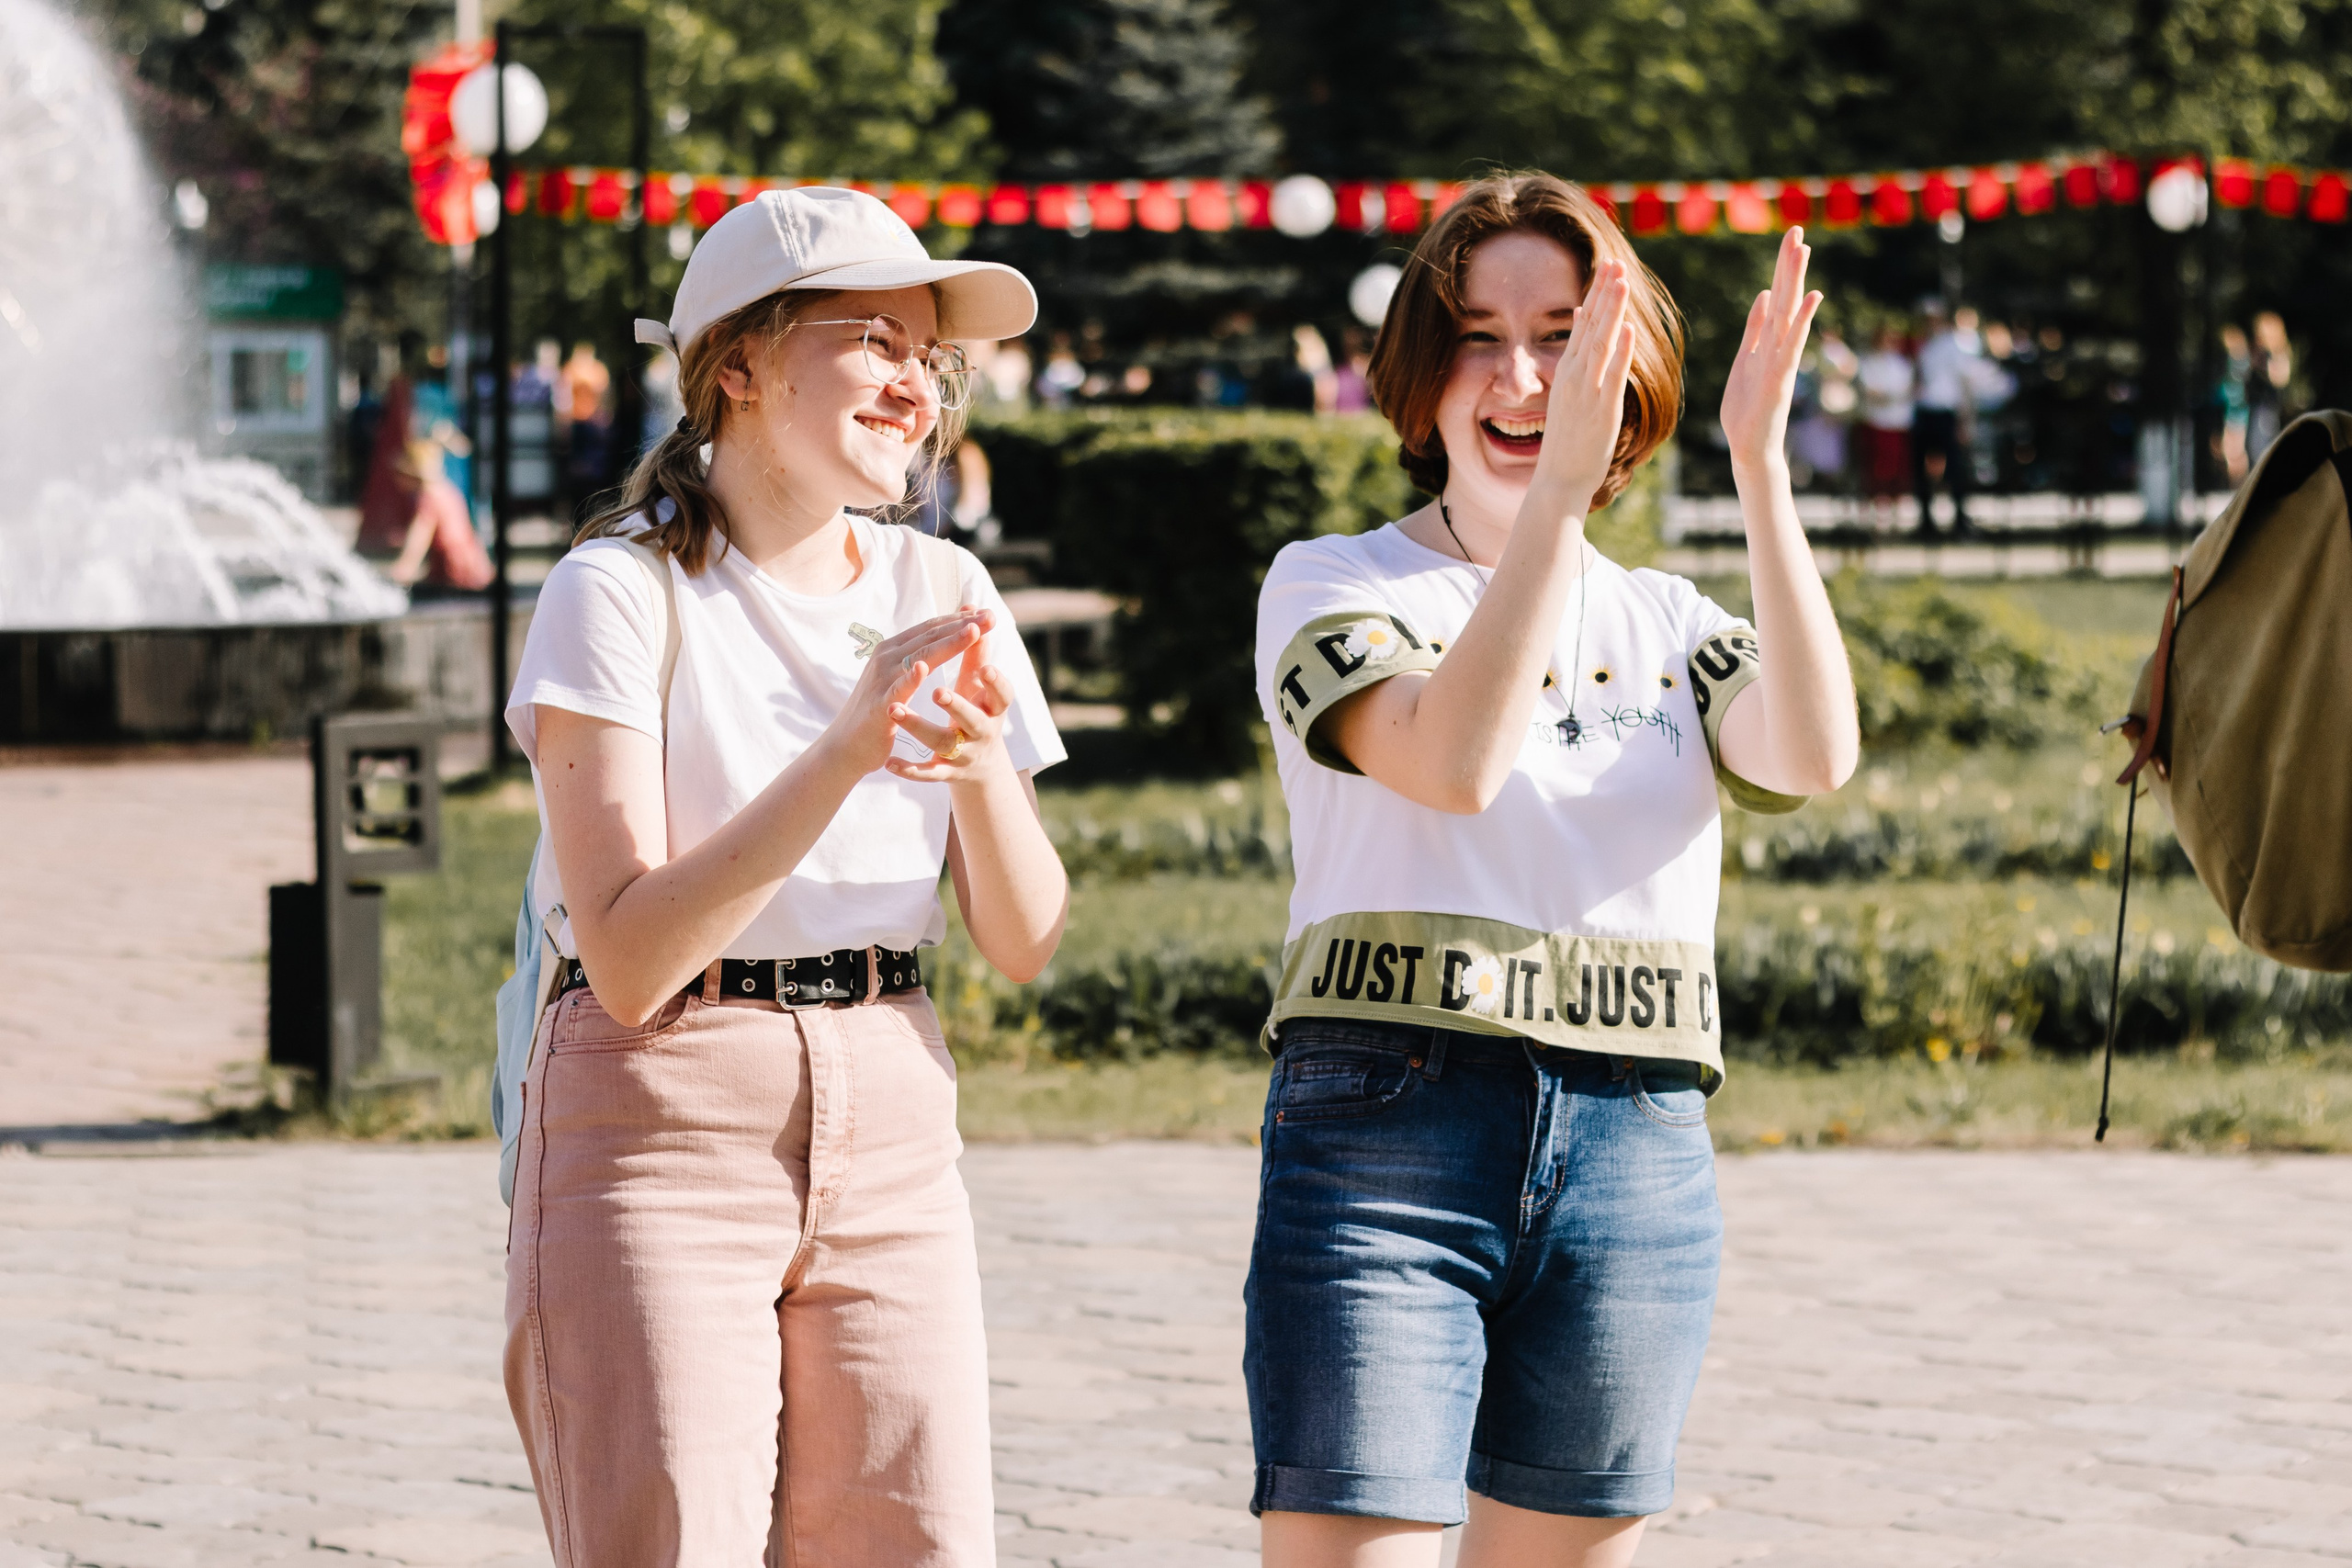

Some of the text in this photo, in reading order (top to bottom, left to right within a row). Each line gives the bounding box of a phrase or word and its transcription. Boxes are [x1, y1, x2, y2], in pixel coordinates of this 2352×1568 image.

[1689, 637, 1759, 716] JUS
[1600, 704, 1683, 758] YOUTH
[1312, 938, 1425, 1004] JUST
[1504, 958, 1555, 1022] IT.
[1566, 964, 1683, 1029] JUST
